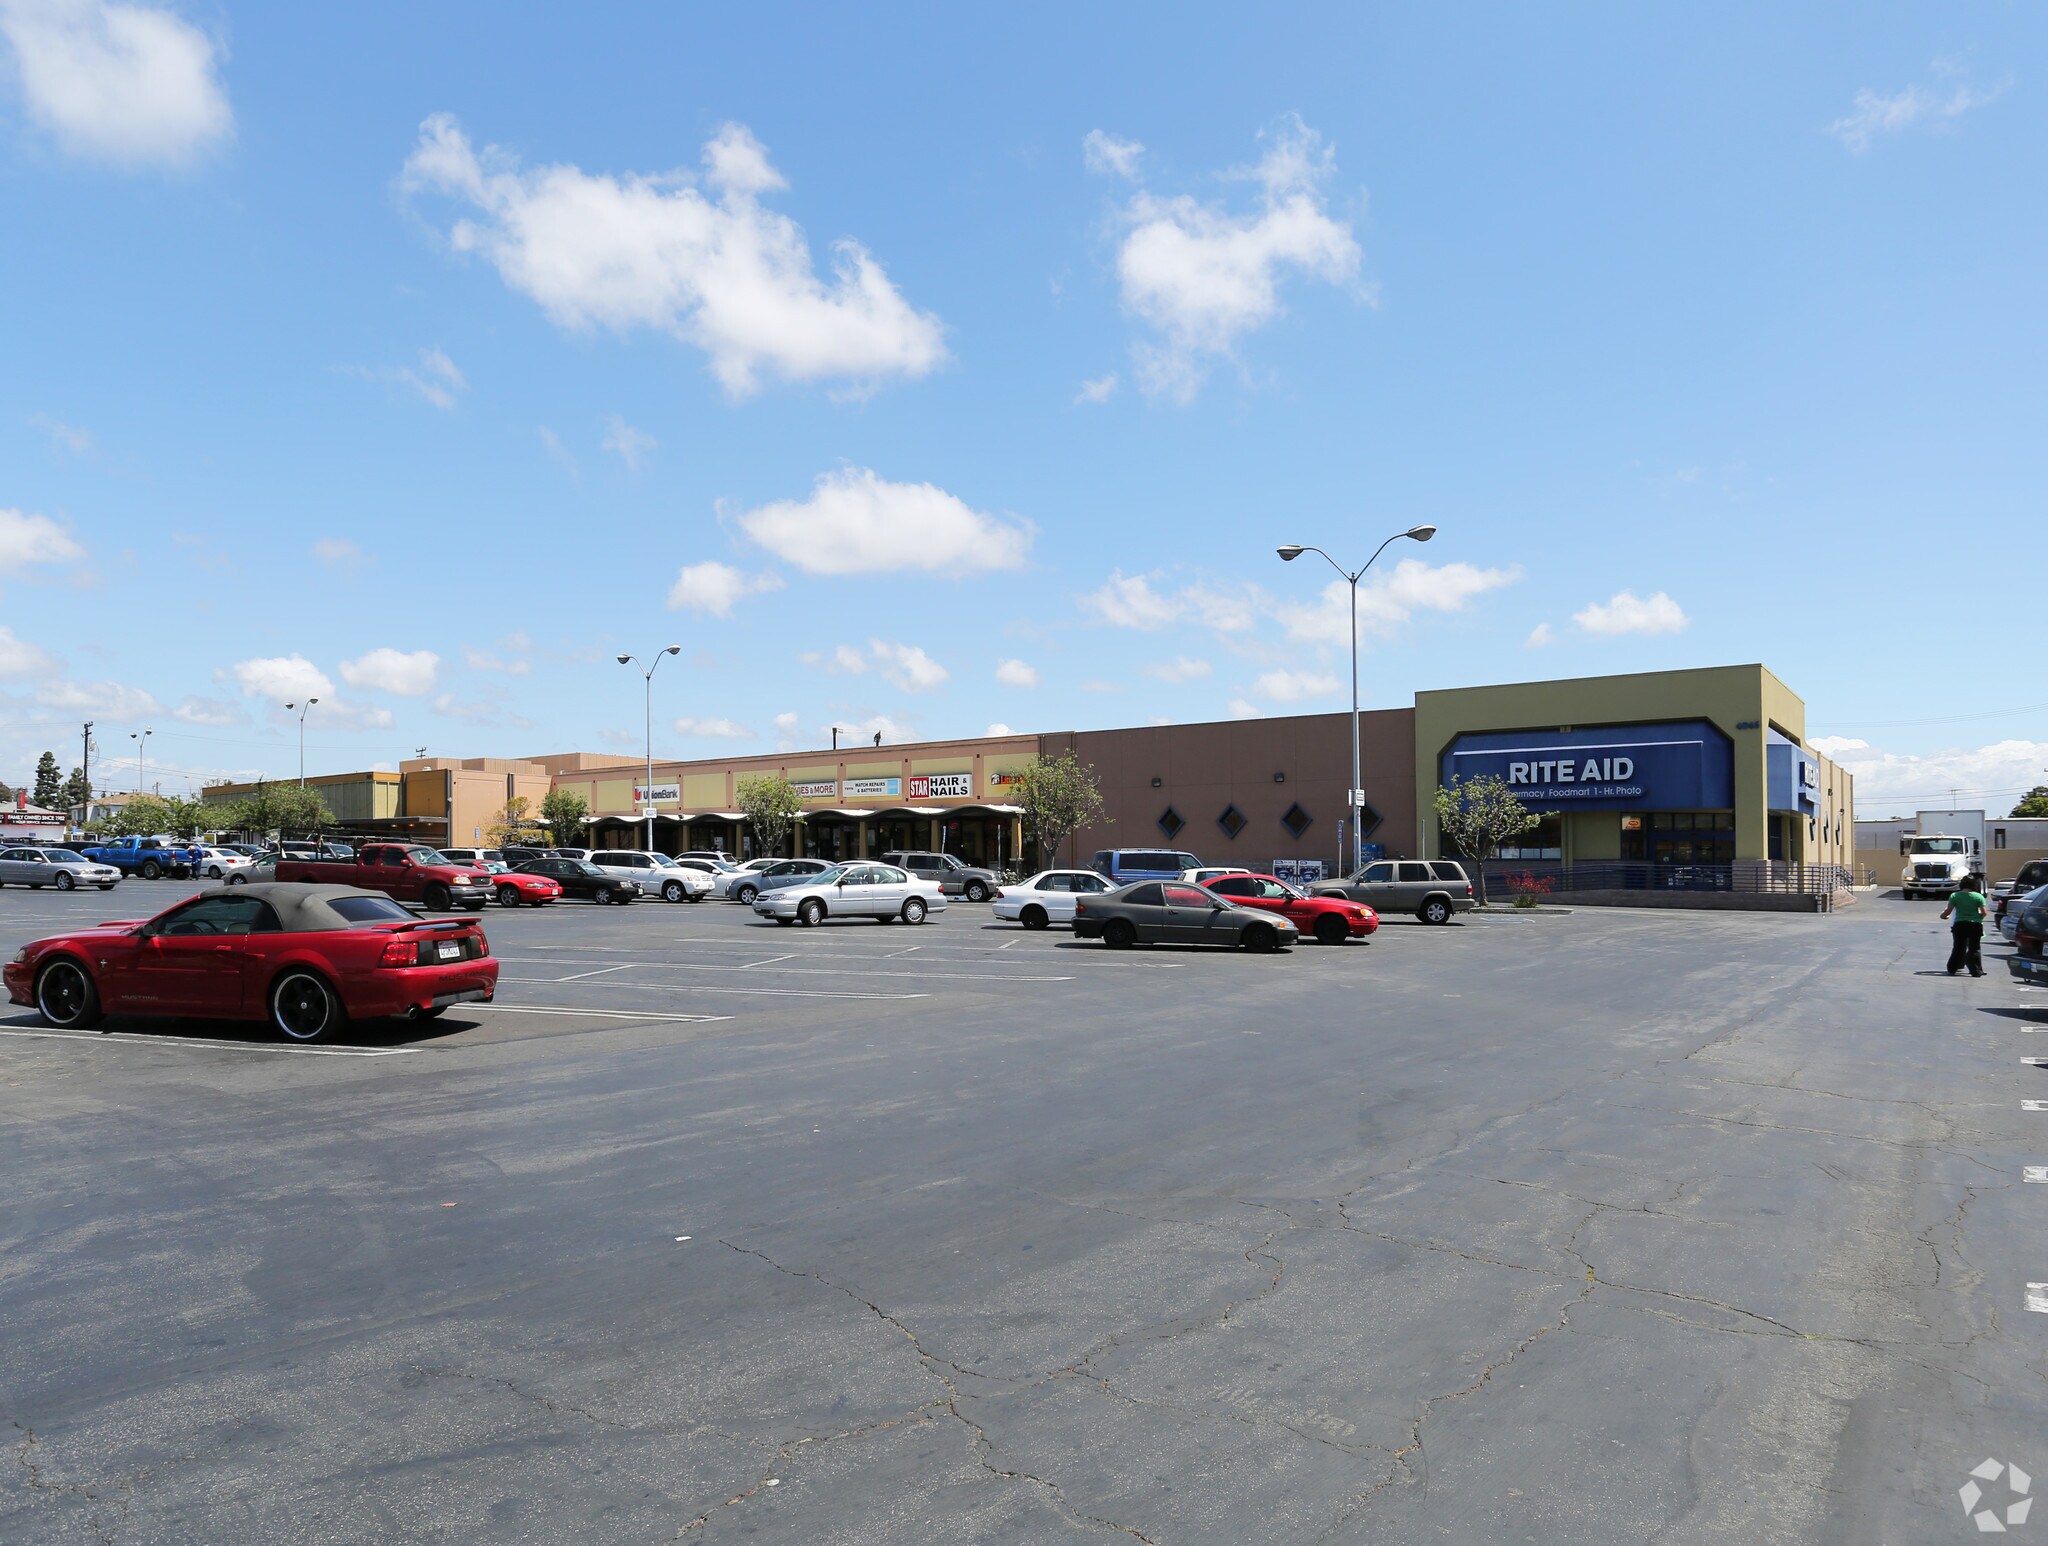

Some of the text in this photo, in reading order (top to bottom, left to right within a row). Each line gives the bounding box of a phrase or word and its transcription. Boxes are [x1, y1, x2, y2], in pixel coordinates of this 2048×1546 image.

[1509, 757, 1634, 784] RITE AID
[930, 777, 959, 786] HAIR
[814, 784, 834, 794] MORE
[910, 780, 928, 796] STAR
[930, 786, 968, 796] NAILS
[1549, 787, 1590, 797] Foodmart
[1616, 785, 1642, 795] Photo
[643, 789, 678, 799] UionBank
